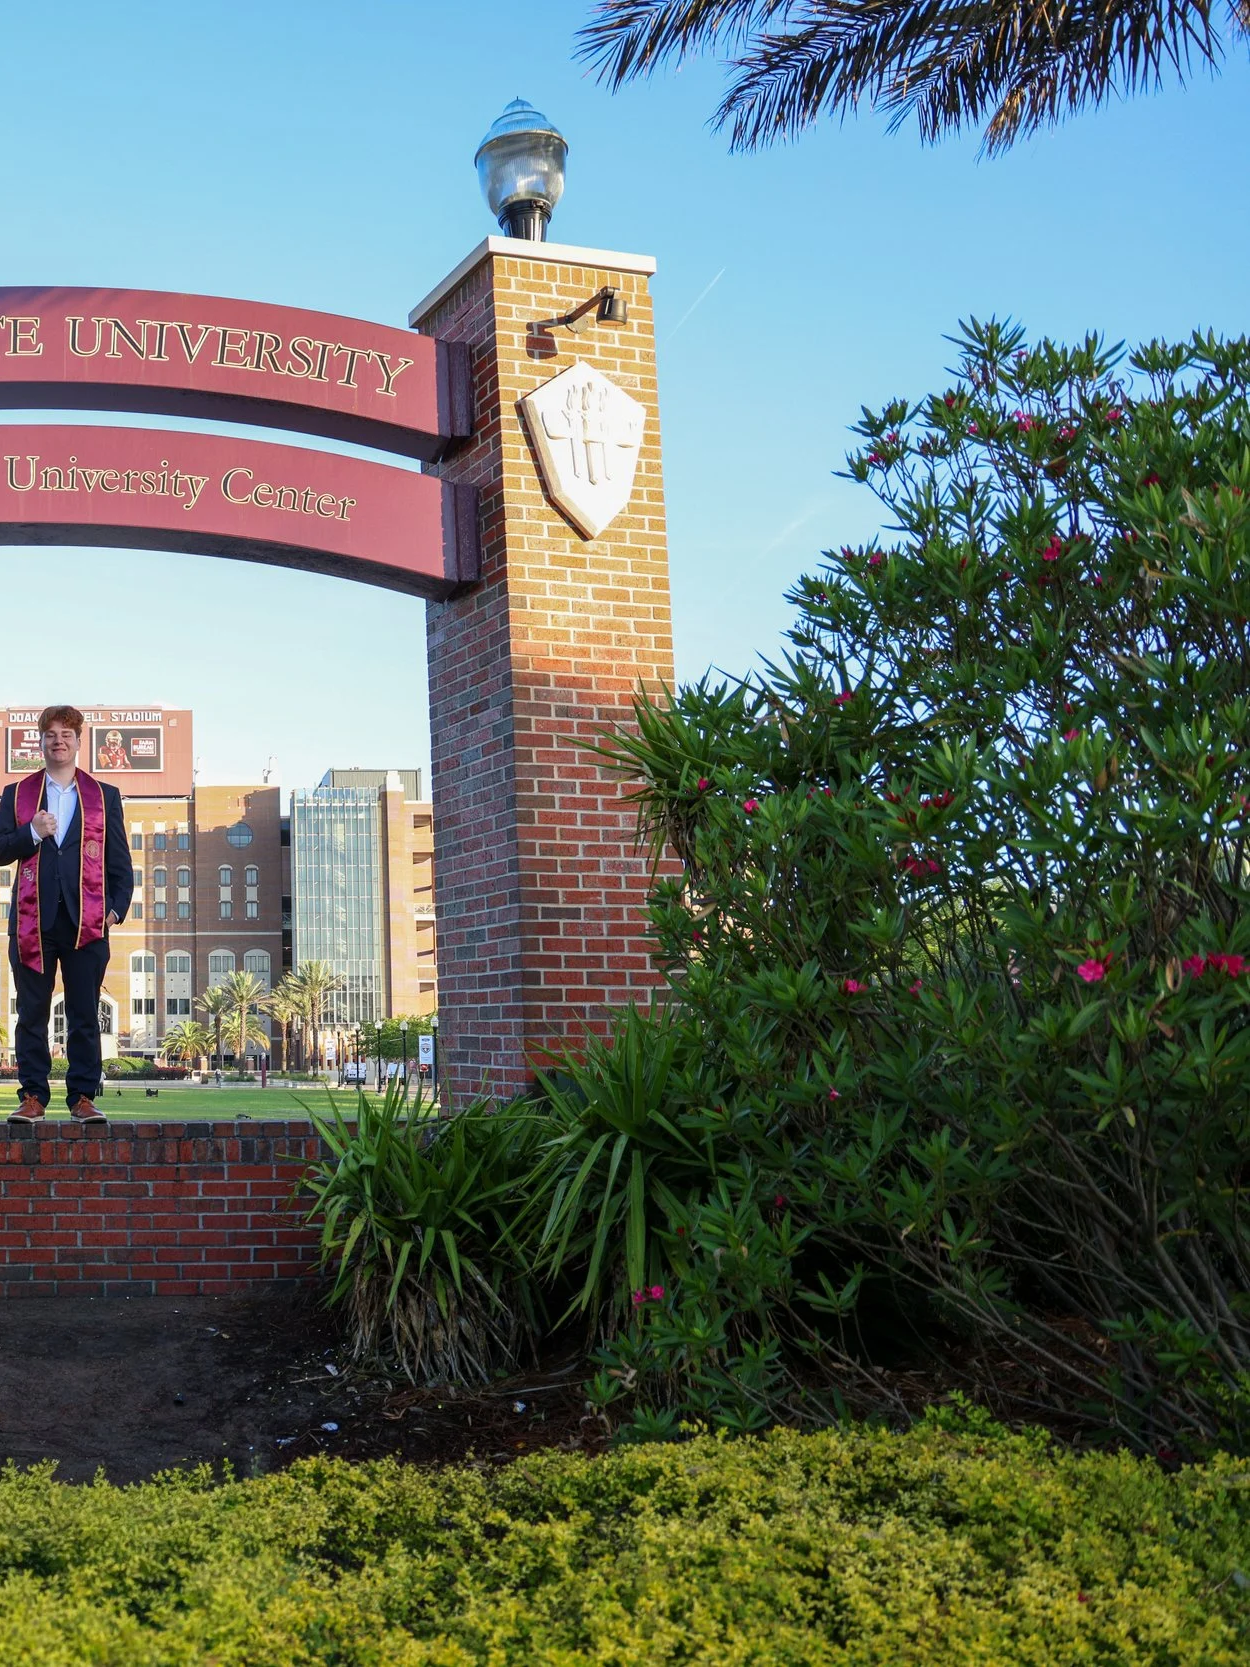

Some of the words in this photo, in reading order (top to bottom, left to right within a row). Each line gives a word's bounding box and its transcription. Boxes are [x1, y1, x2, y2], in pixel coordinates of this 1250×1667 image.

[66, 317, 414, 396] UNIVERSITY
[4, 455, 209, 510] University
[220, 467, 357, 521] Center
[9, 712, 39, 723] DOAK
[111, 711, 162, 722] STADIUM
